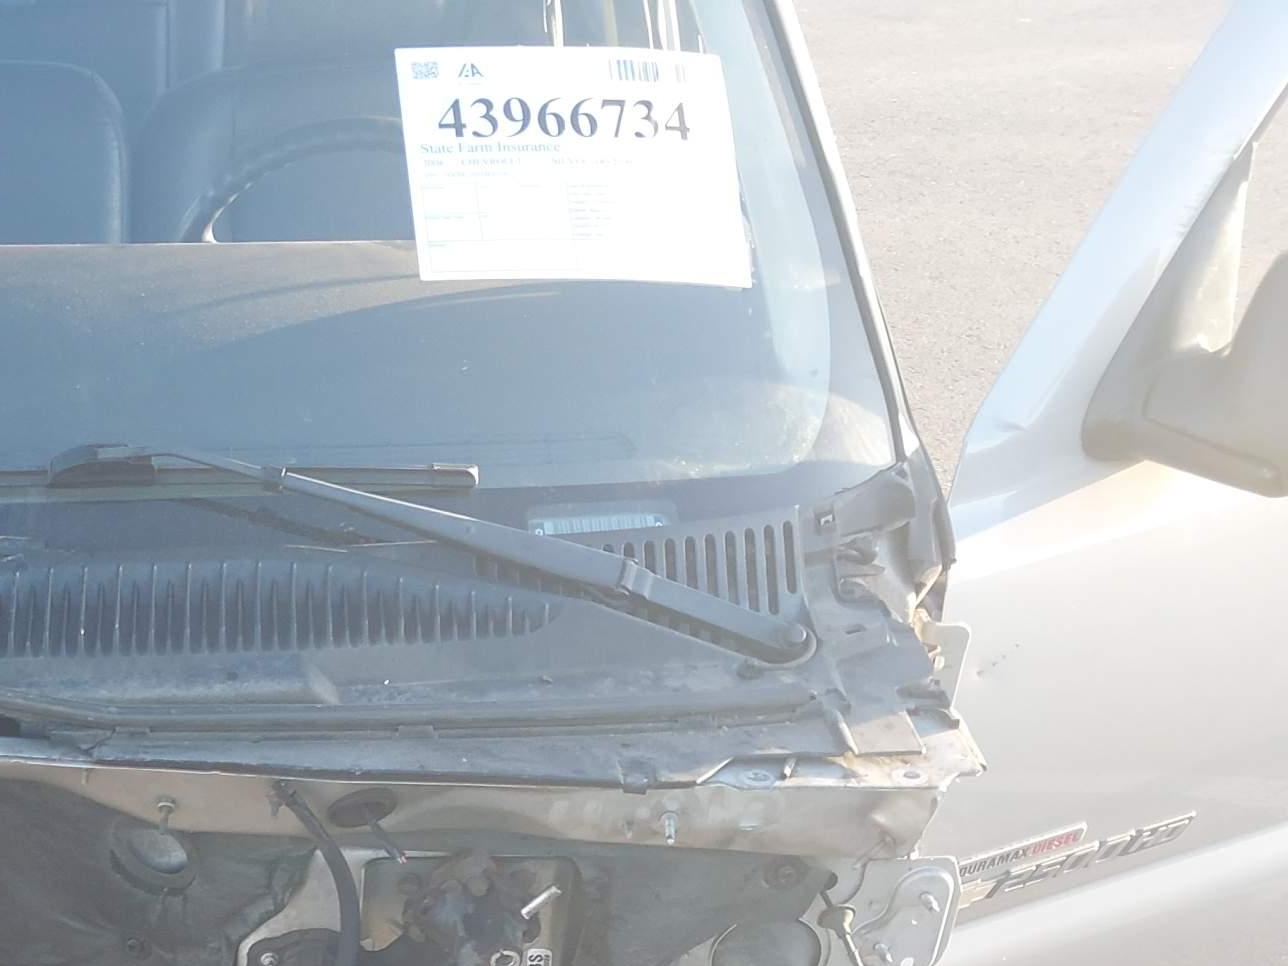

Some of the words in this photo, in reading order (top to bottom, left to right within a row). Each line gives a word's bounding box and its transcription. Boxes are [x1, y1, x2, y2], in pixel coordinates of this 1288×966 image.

[438, 97, 691, 140] 43966734
[420, 143, 454, 154] State
[497, 142, 561, 153] Insurance
[959, 847, 1029, 877] DURAMAX
[1031, 830, 1080, 856] DIESEL
